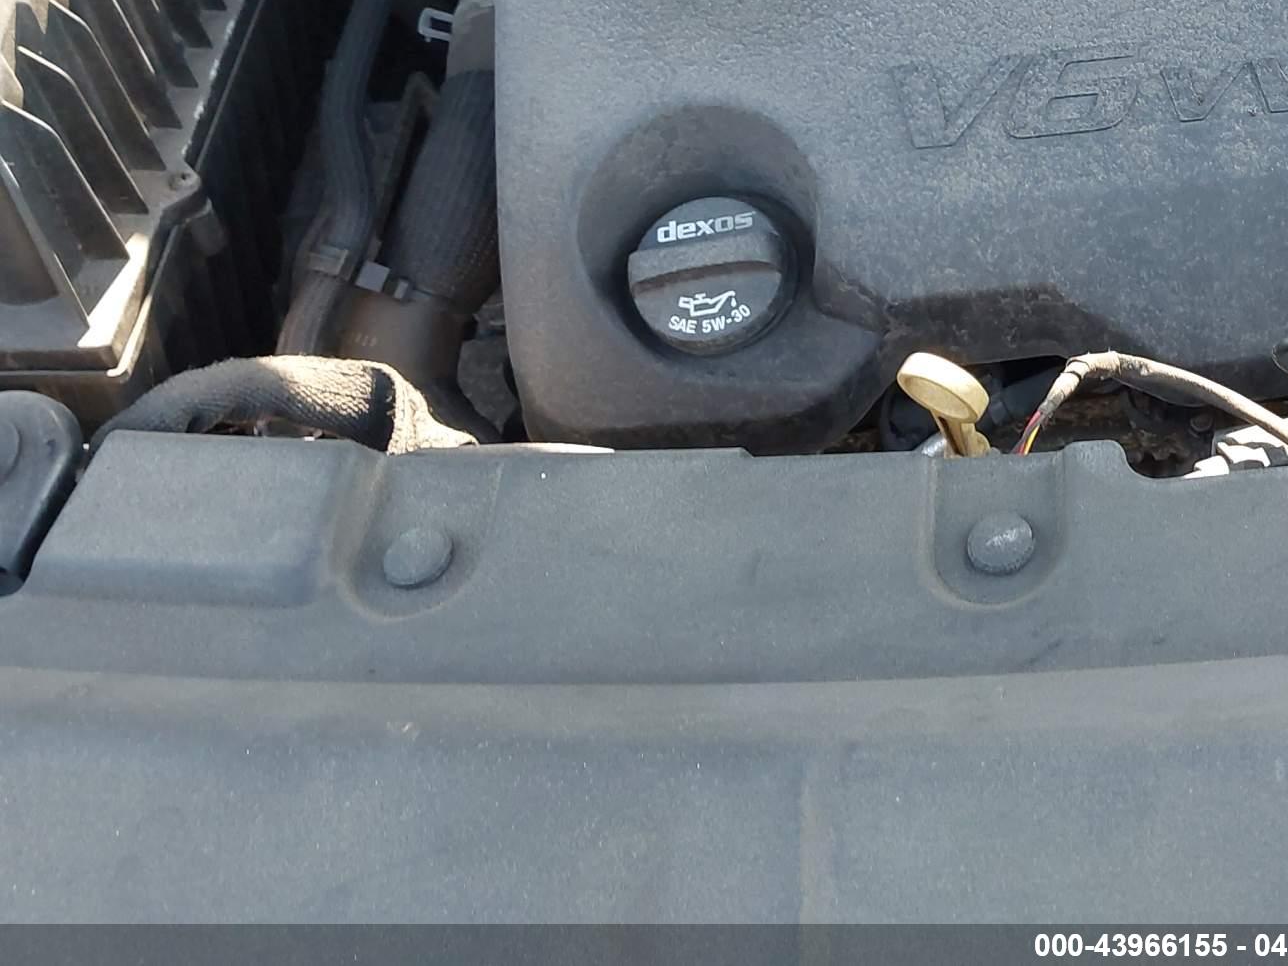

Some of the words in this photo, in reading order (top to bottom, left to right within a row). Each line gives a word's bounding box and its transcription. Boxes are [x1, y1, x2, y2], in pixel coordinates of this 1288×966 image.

[889, 44, 1143, 150] V6
[657, 212, 753, 243] dexos
[669, 315, 697, 334] SAE
[702, 304, 751, 333] 5W-30
